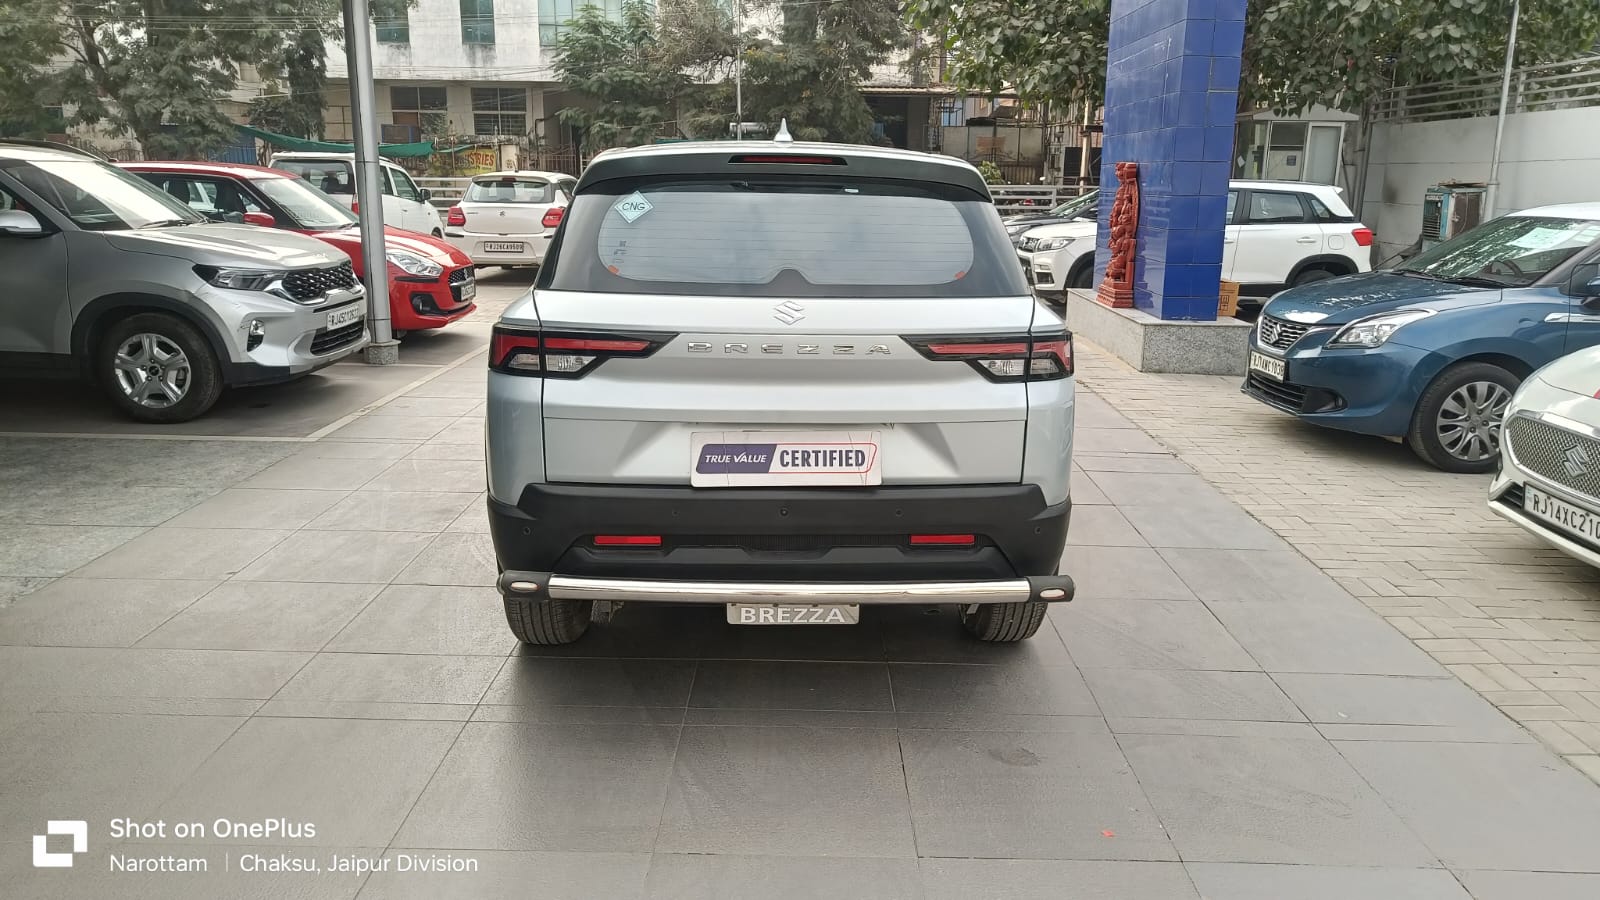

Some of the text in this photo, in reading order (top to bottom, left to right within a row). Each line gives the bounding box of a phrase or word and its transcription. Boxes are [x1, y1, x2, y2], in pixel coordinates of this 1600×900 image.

[622, 202, 646, 211] CNG
[687, 342, 892, 355] BREZZA
[705, 449, 866, 468] TRUE VALUE CERTIFIED
[740, 607, 845, 623] BREZZA
